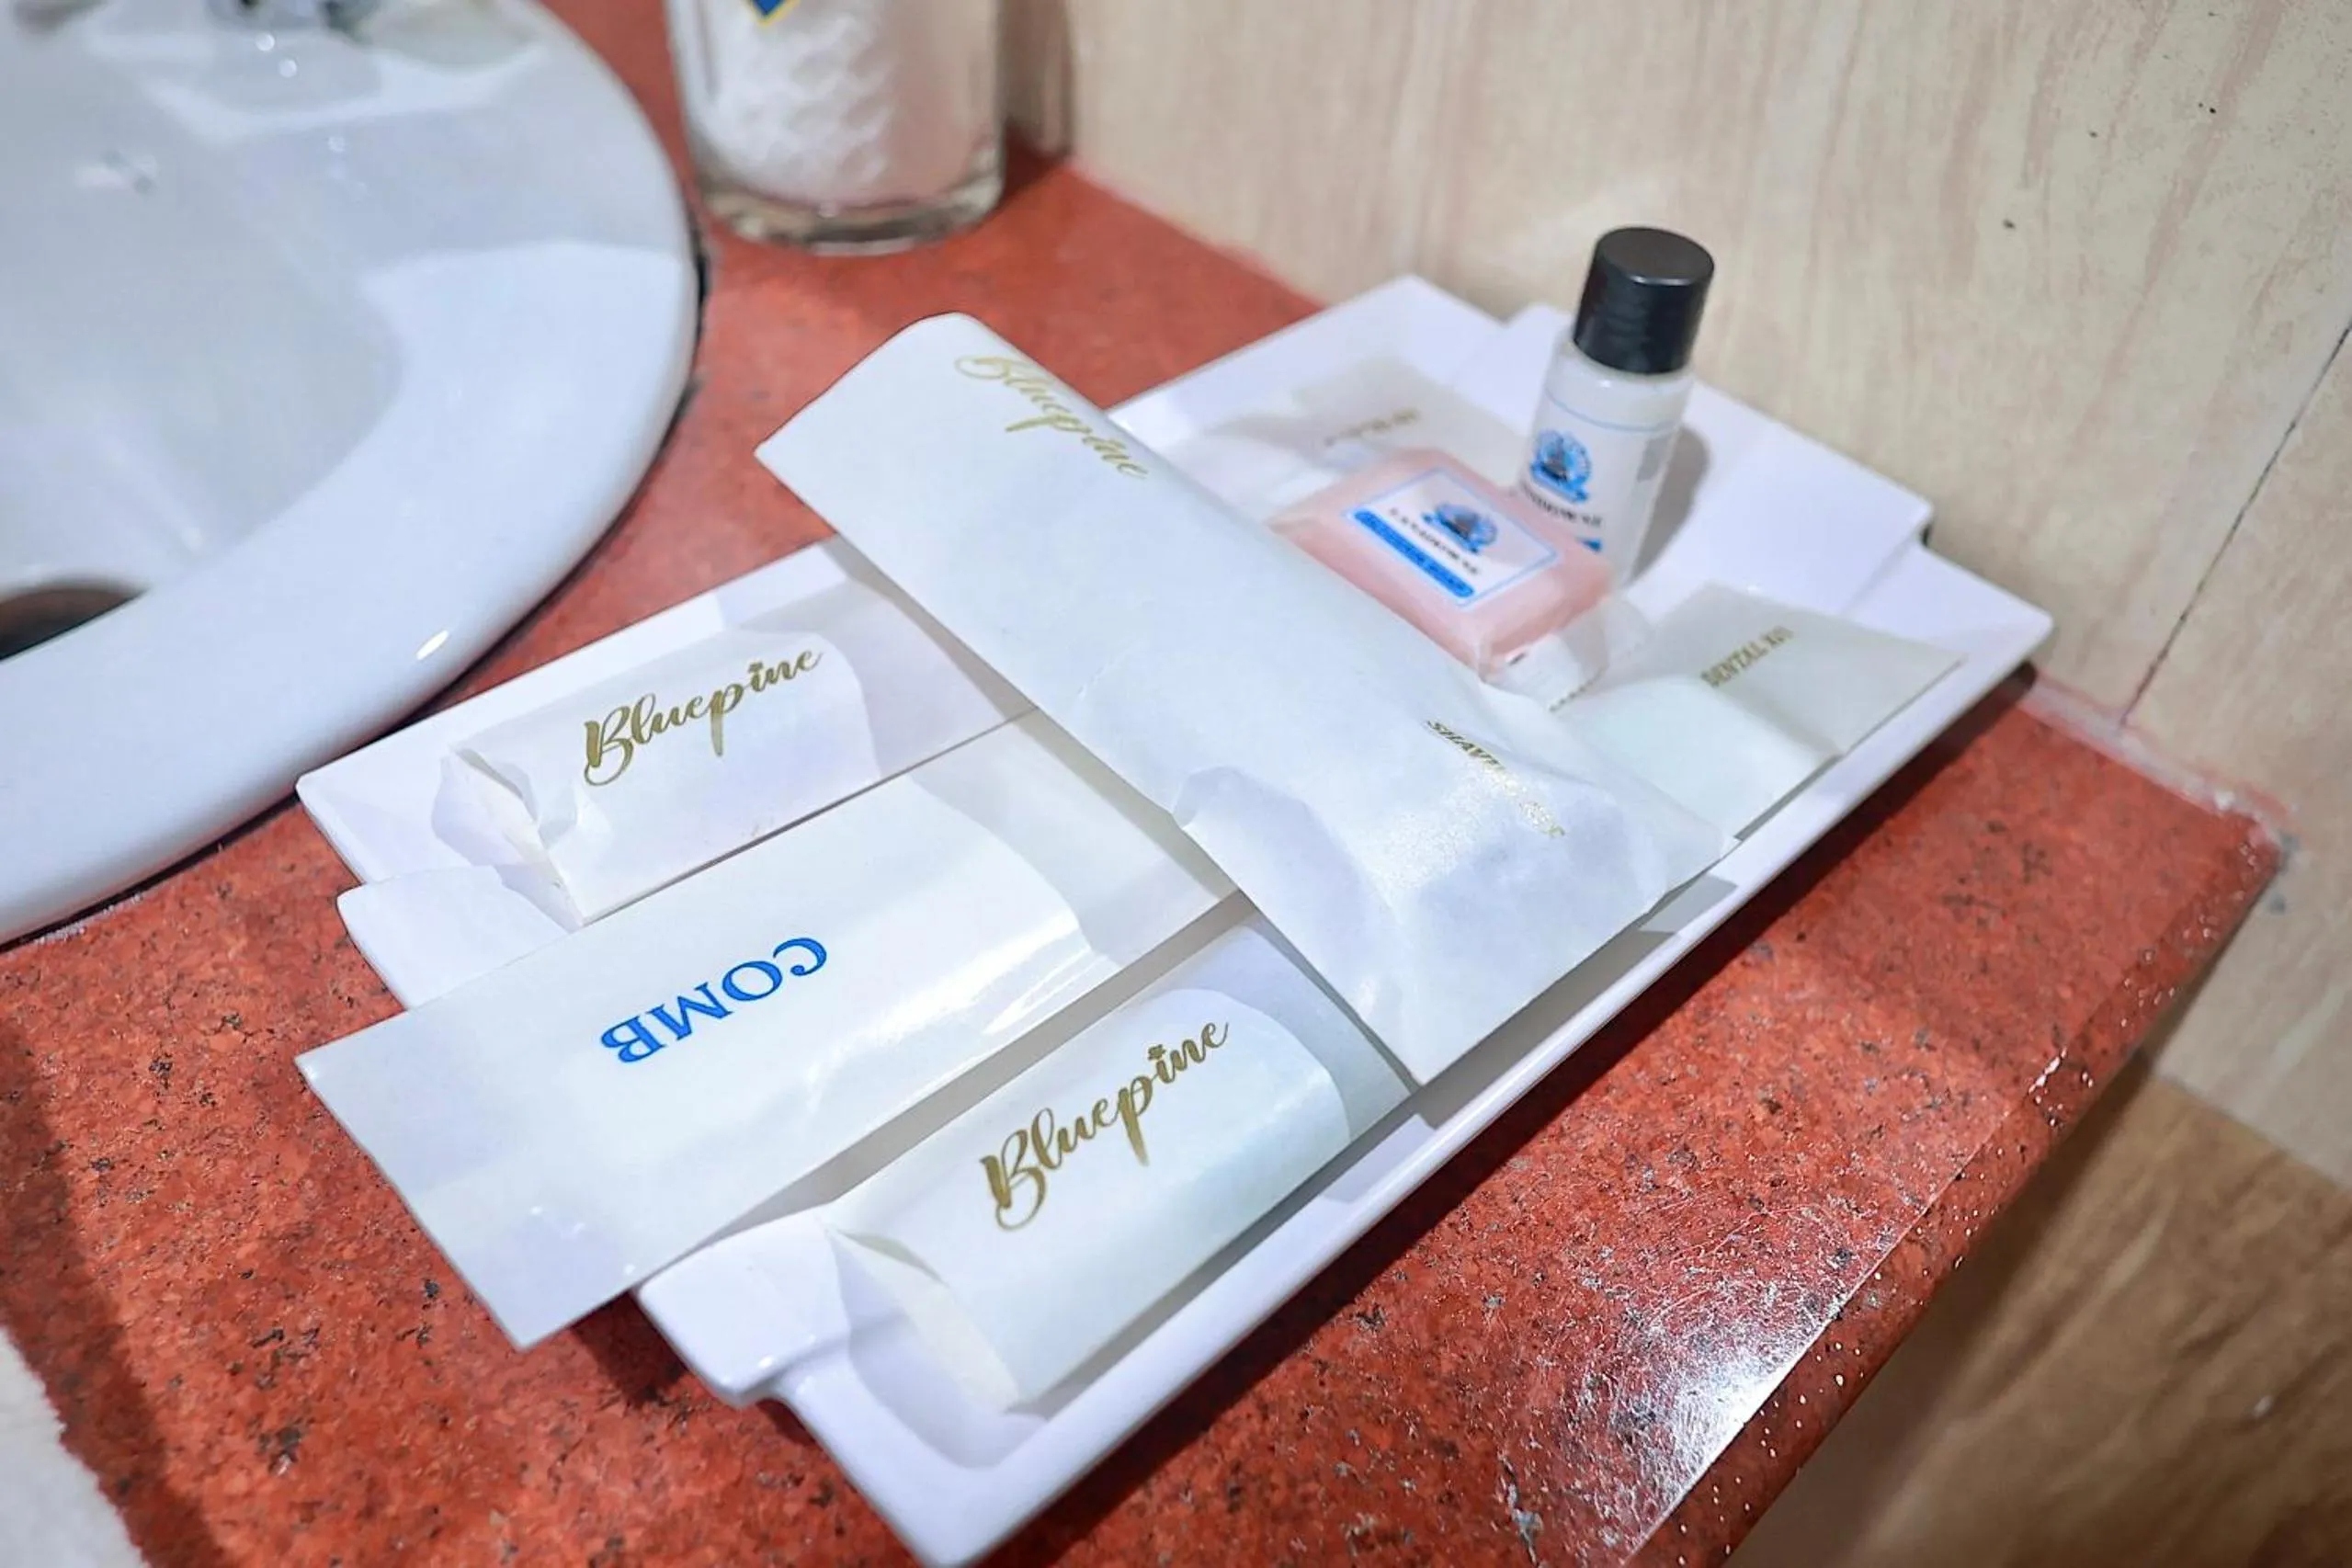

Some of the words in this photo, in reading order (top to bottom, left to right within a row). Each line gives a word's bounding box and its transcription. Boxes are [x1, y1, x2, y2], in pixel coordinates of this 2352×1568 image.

[954, 355, 1148, 479] Bluepine
[584, 650, 824, 786] Bluepine
[600, 937, 827, 1063] COMB
[979, 1021, 1230, 1232] Bluepine
